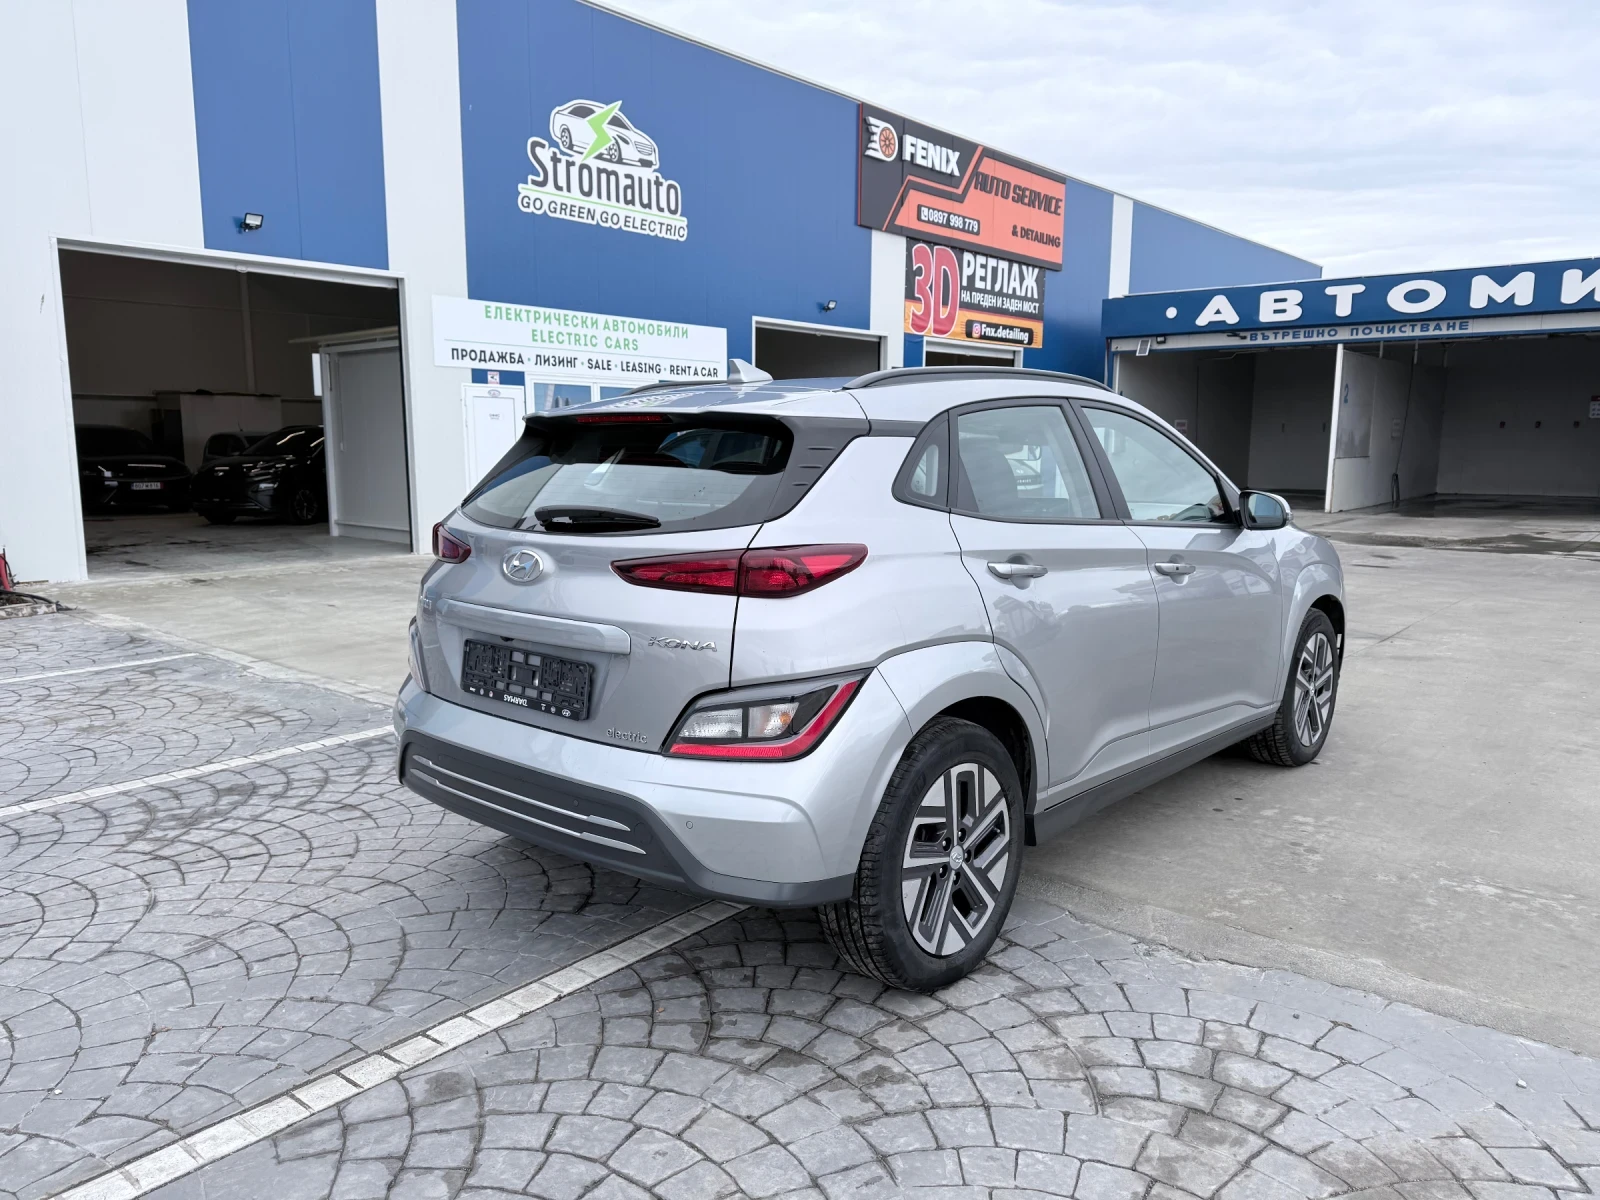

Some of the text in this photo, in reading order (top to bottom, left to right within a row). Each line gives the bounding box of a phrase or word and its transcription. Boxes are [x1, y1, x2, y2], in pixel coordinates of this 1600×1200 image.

[903, 134, 960, 176] FENIX
[530, 140, 680, 215] Stromauto
[974, 171, 1063, 217] AUTO SERVICE
[521, 196, 686, 238] GO GREEN GO ELECTRIC
[928, 208, 978, 233] 0897 998 779
[1011, 224, 1061, 249] & DETAILING
[910, 243, 960, 337] 3D
[961, 250, 1039, 299] РЕГЛАЖ
[961, 290, 1040, 314] НА ПРЕДЕН И ЗАДЕН МОСТ
[1195, 268, 1600, 326] АВТОМИ
[484, 304, 689, 339] ЕЛЕКТРИЧЕСКИ АВТОМОБИЛИ
[981, 323, 1029, 344] Fnx.detailing
[1250, 320, 1470, 342] ВЪТРЕШНО ПОЧИСТВАНЕ
[531, 329, 639, 351] ELECTRIC CARS
[451, 347, 524, 365] ПРОДАЖБА
[534, 354, 578, 369] ЛИЗИНГ
[587, 358, 612, 371] SALE
[620, 360, 661, 374] LEASING
[670, 364, 691, 377] RENT
[700, 366, 718, 379] CAR
[648, 636, 718, 652] KONA
[606, 727, 648, 744] electric
